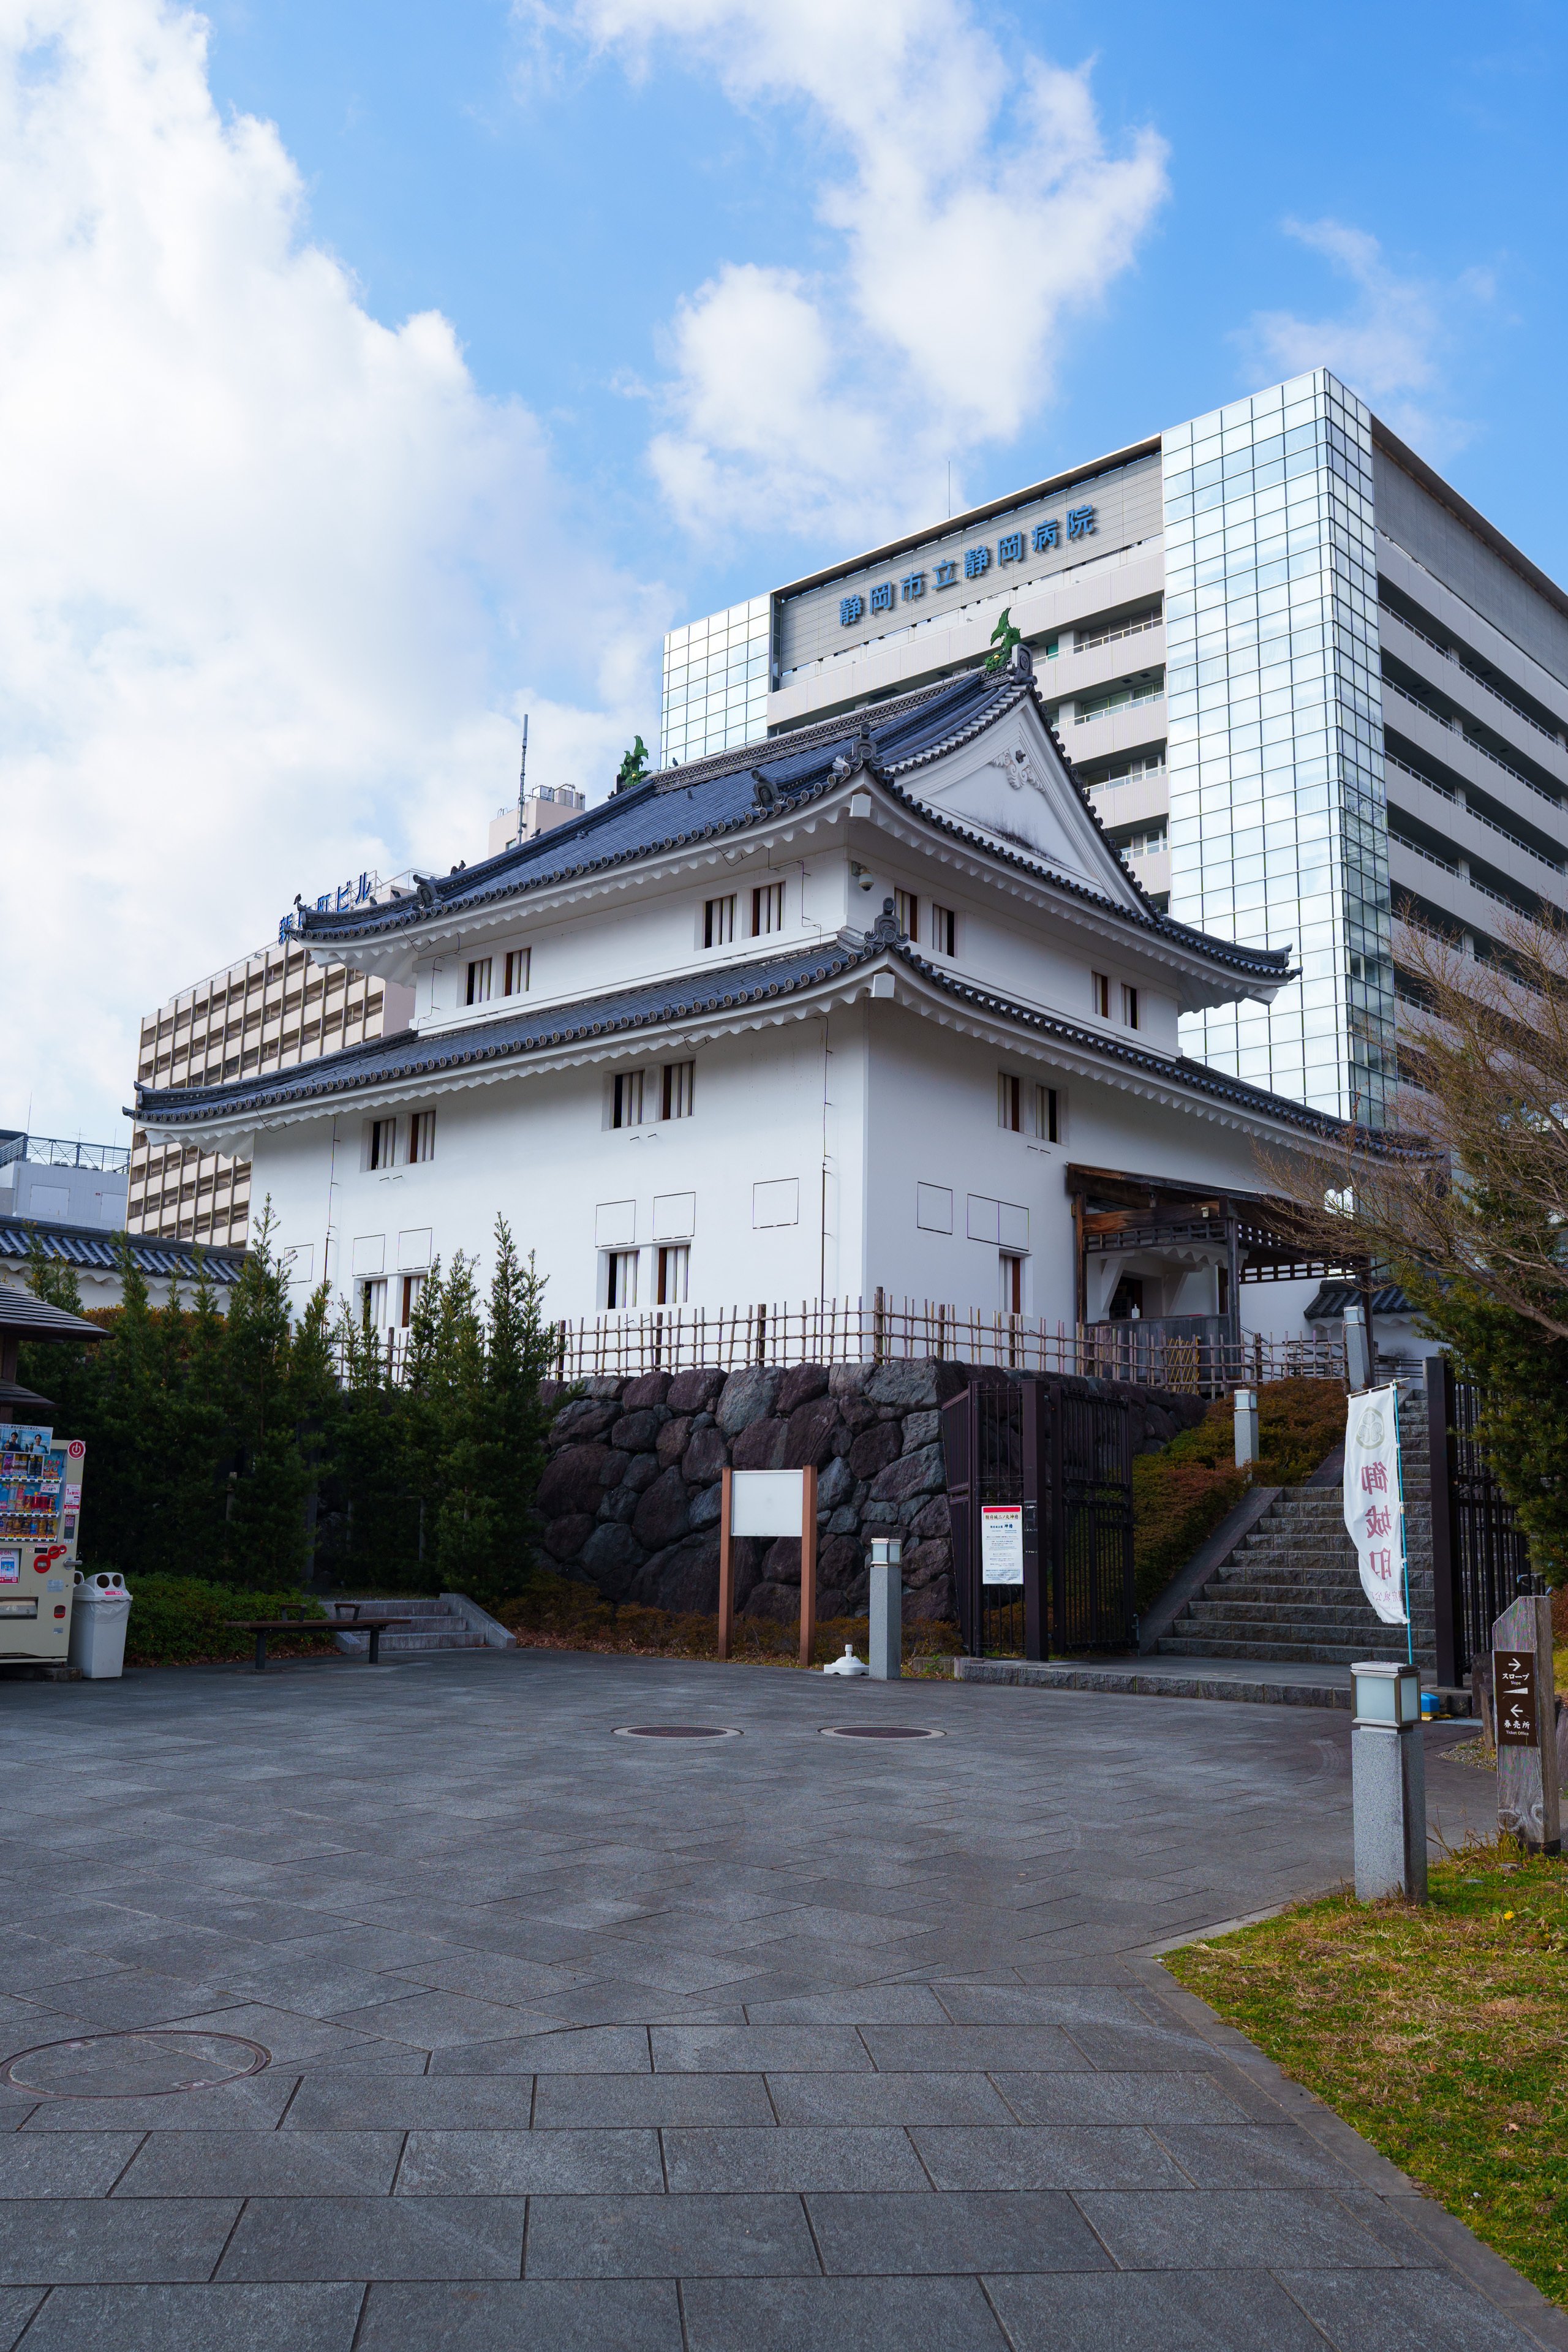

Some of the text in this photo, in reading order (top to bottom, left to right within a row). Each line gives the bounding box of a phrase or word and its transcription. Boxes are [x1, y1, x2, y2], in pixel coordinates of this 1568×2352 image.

[839, 504, 1096, 627] 静岡市立静岡病院
[279, 872, 372, 945] 新町ビル
[1504, 1719, 1530, 1730] 券売所
